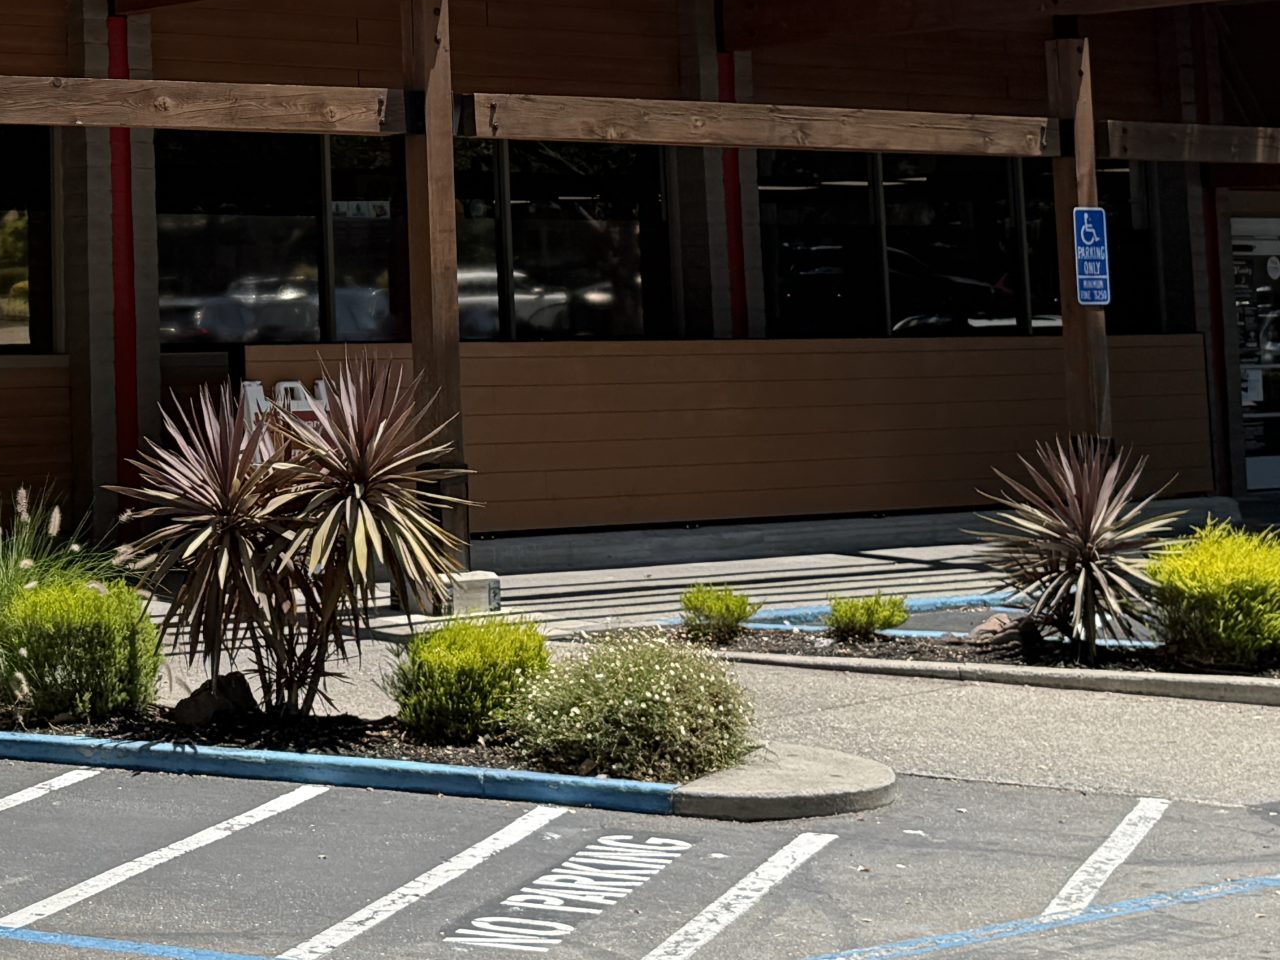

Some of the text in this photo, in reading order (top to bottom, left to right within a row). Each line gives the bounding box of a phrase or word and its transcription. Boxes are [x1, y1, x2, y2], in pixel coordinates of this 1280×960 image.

[1078, 246, 1105, 260] PARKING
[1084, 261, 1101, 274] ONLY
[442, 834, 693, 953] NO PARKING
